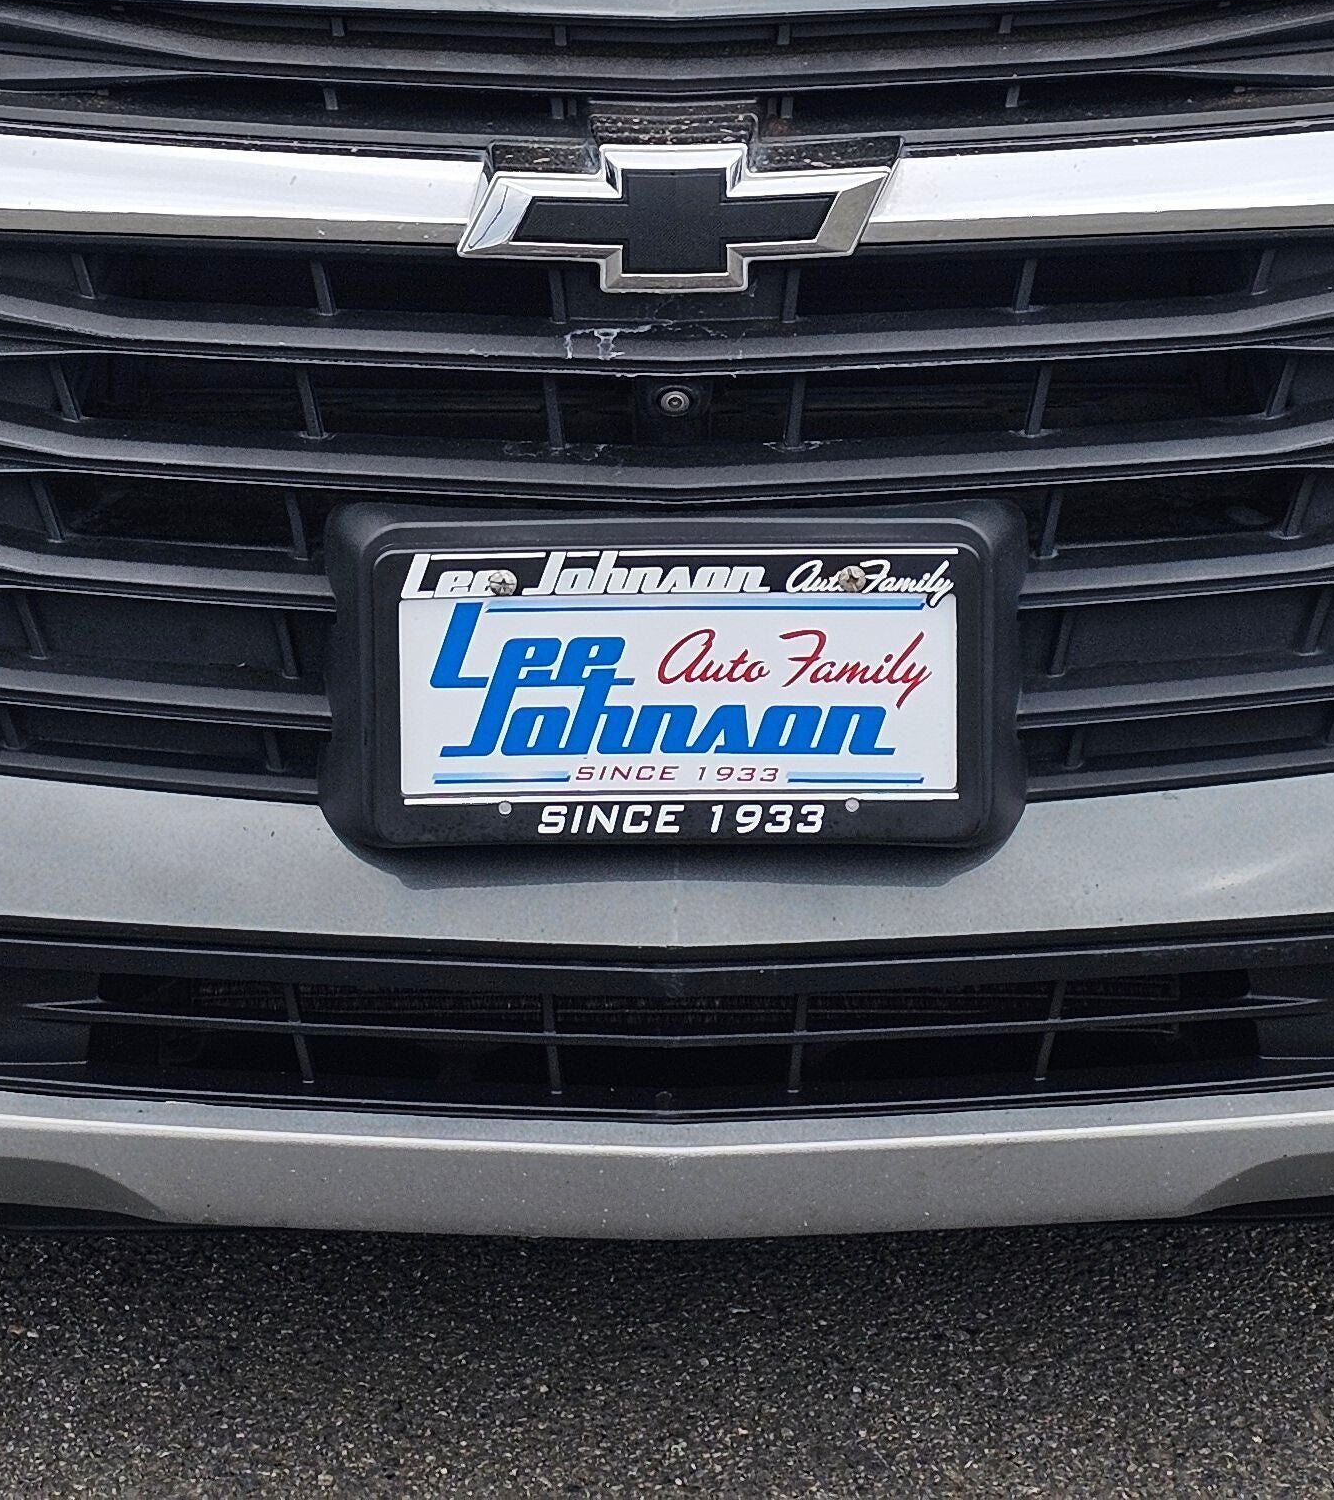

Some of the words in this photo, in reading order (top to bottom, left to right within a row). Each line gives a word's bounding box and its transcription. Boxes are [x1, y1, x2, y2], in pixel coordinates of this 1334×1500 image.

[401, 553, 514, 598] Lee
[521, 551, 770, 596] Johnson
[785, 559, 865, 594] Aut
[860, 559, 955, 608] Family
[430, 602, 635, 688] Lee
[657, 628, 770, 684] Auto
[779, 629, 932, 709] Family
[440, 668, 895, 757] Johnson
[576, 765, 680, 782] SINCE
[698, 766, 780, 782] 1933
[537, 804, 685, 834] SINCE
[710, 804, 825, 834] 1933
